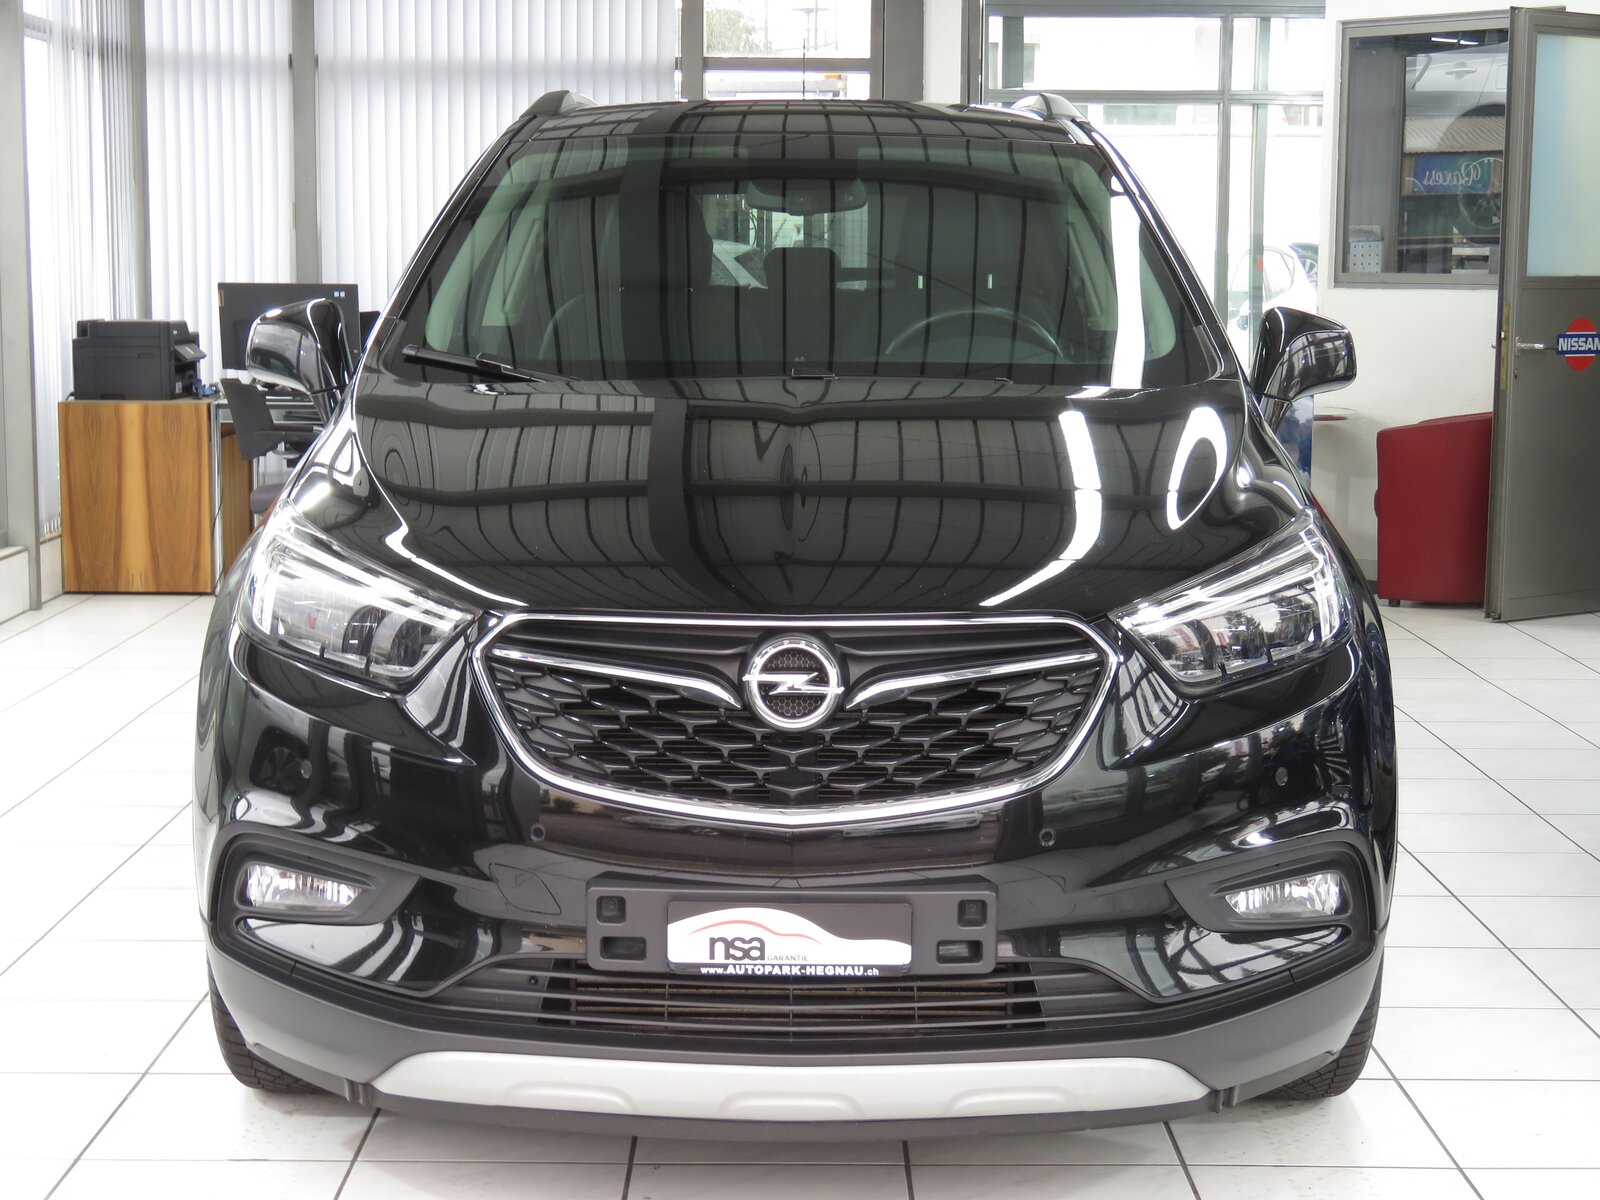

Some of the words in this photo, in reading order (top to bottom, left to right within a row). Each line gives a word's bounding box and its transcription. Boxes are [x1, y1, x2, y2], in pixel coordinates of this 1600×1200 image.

[1558, 337, 1600, 351] NISSAN
[709, 937, 766, 961] nsa
[767, 954, 809, 962] GARANTIE
[700, 964, 880, 976] www.AUTOPARK-HEGNAU.ch
